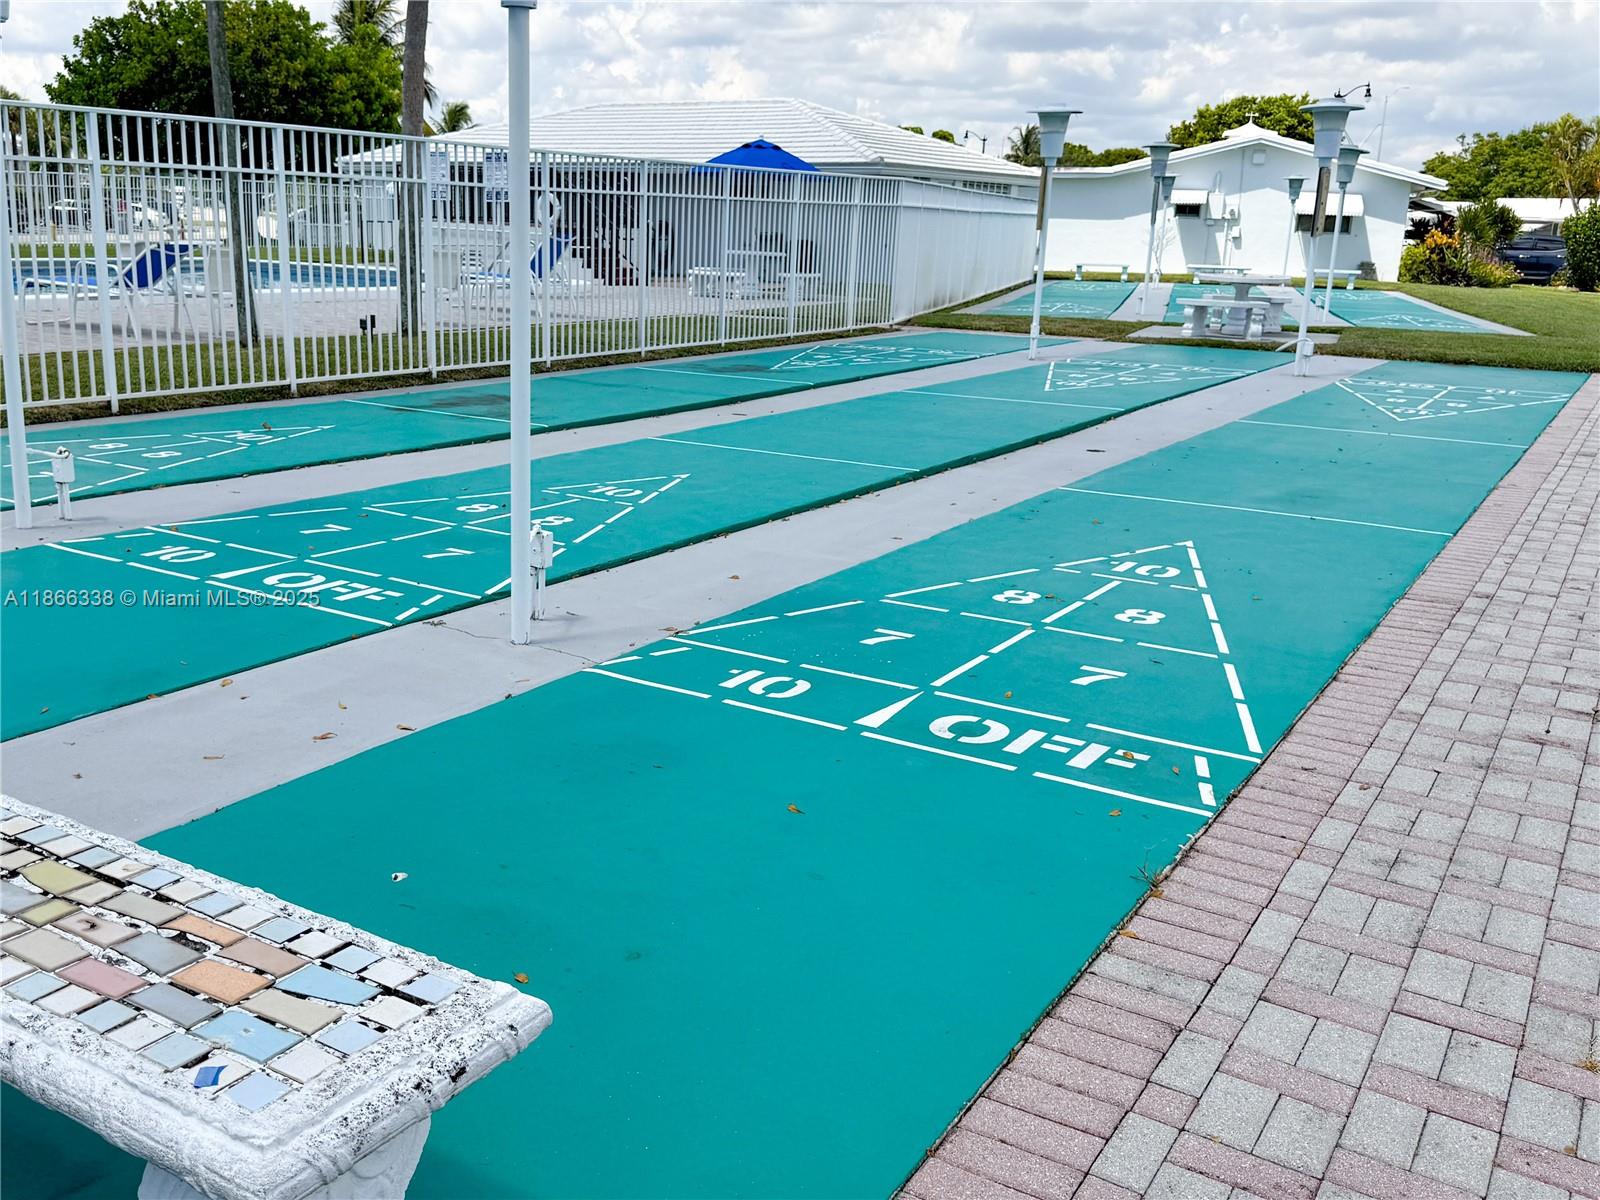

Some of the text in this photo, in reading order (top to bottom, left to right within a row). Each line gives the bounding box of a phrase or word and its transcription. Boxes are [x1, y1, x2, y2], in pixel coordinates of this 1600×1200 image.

[141, 450, 182, 458] 8
[588, 485, 643, 498] 10
[456, 503, 499, 513] 8
[300, 523, 352, 534] 7
[531, 515, 574, 527] 8
[422, 547, 475, 559] 7
[140, 545, 405, 601] 10 OFF
[1109, 560, 1181, 579] 10
[992, 589, 1042, 605] 8
[1113, 608, 1166, 625] 8
[859, 628, 915, 645] 7
[1070, 665, 1128, 686] 7
[718, 668, 1151, 769] 10 OFF
